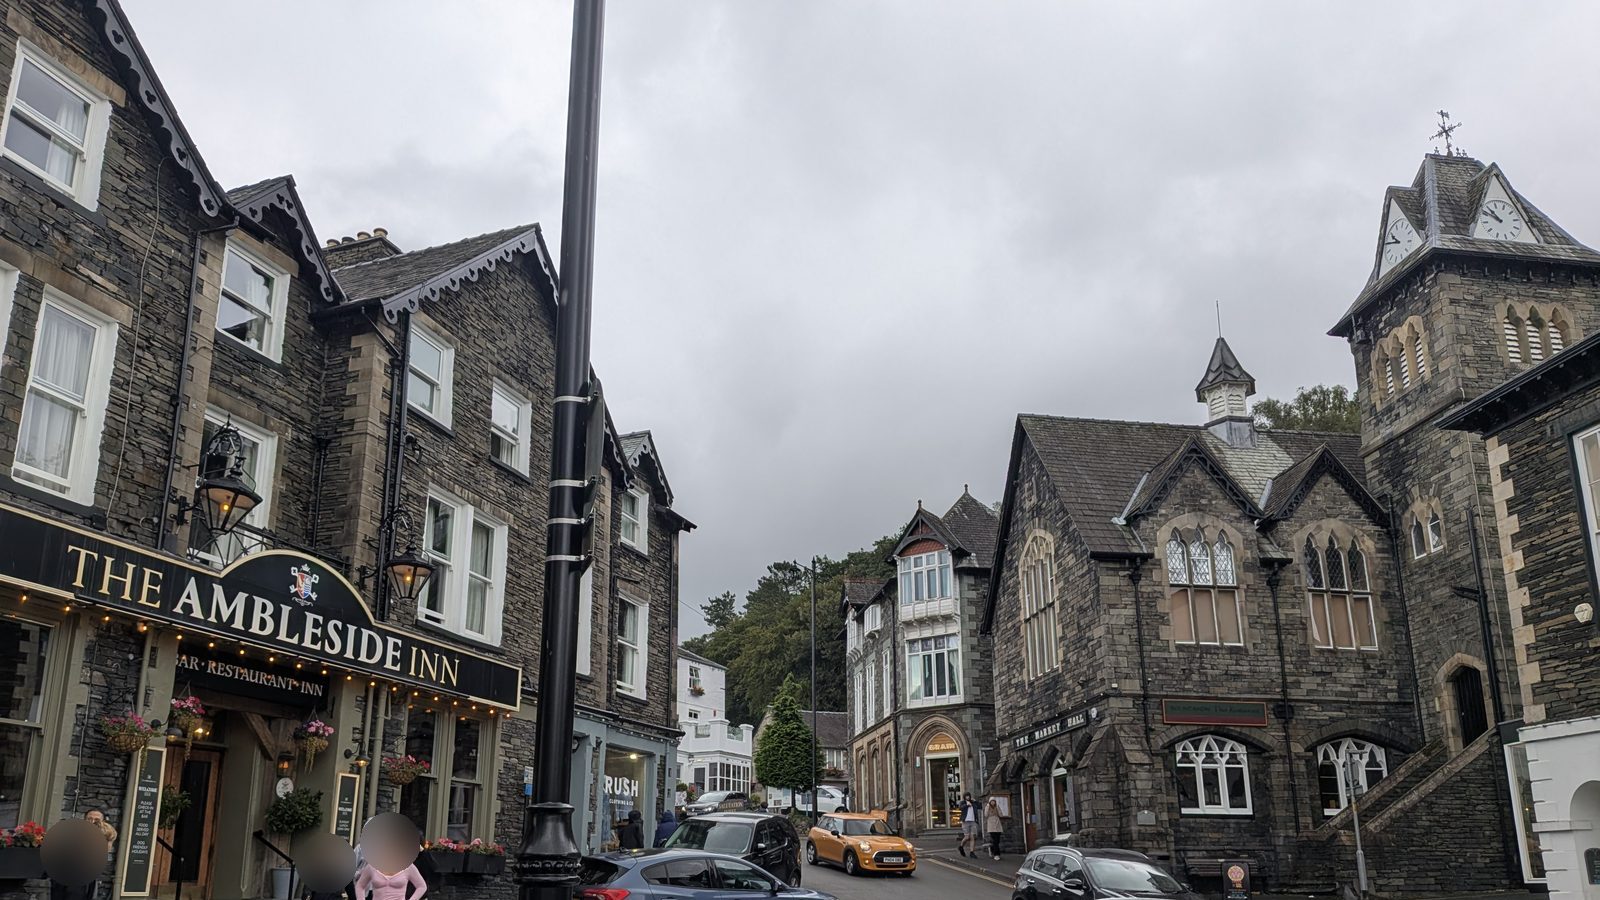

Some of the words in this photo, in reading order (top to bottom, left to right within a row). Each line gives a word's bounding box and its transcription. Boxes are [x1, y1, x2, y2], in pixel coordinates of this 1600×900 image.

[67, 545, 164, 609] THE
[172, 576, 402, 672] AMBLESIDE
[408, 646, 460, 687] INN
[206, 659, 295, 691] RESTAURANT
[300, 680, 324, 697] INN
[1015, 735, 1029, 747] THE
[1034, 722, 1060, 740] MARKET
[1067, 714, 1084, 727] HALL
